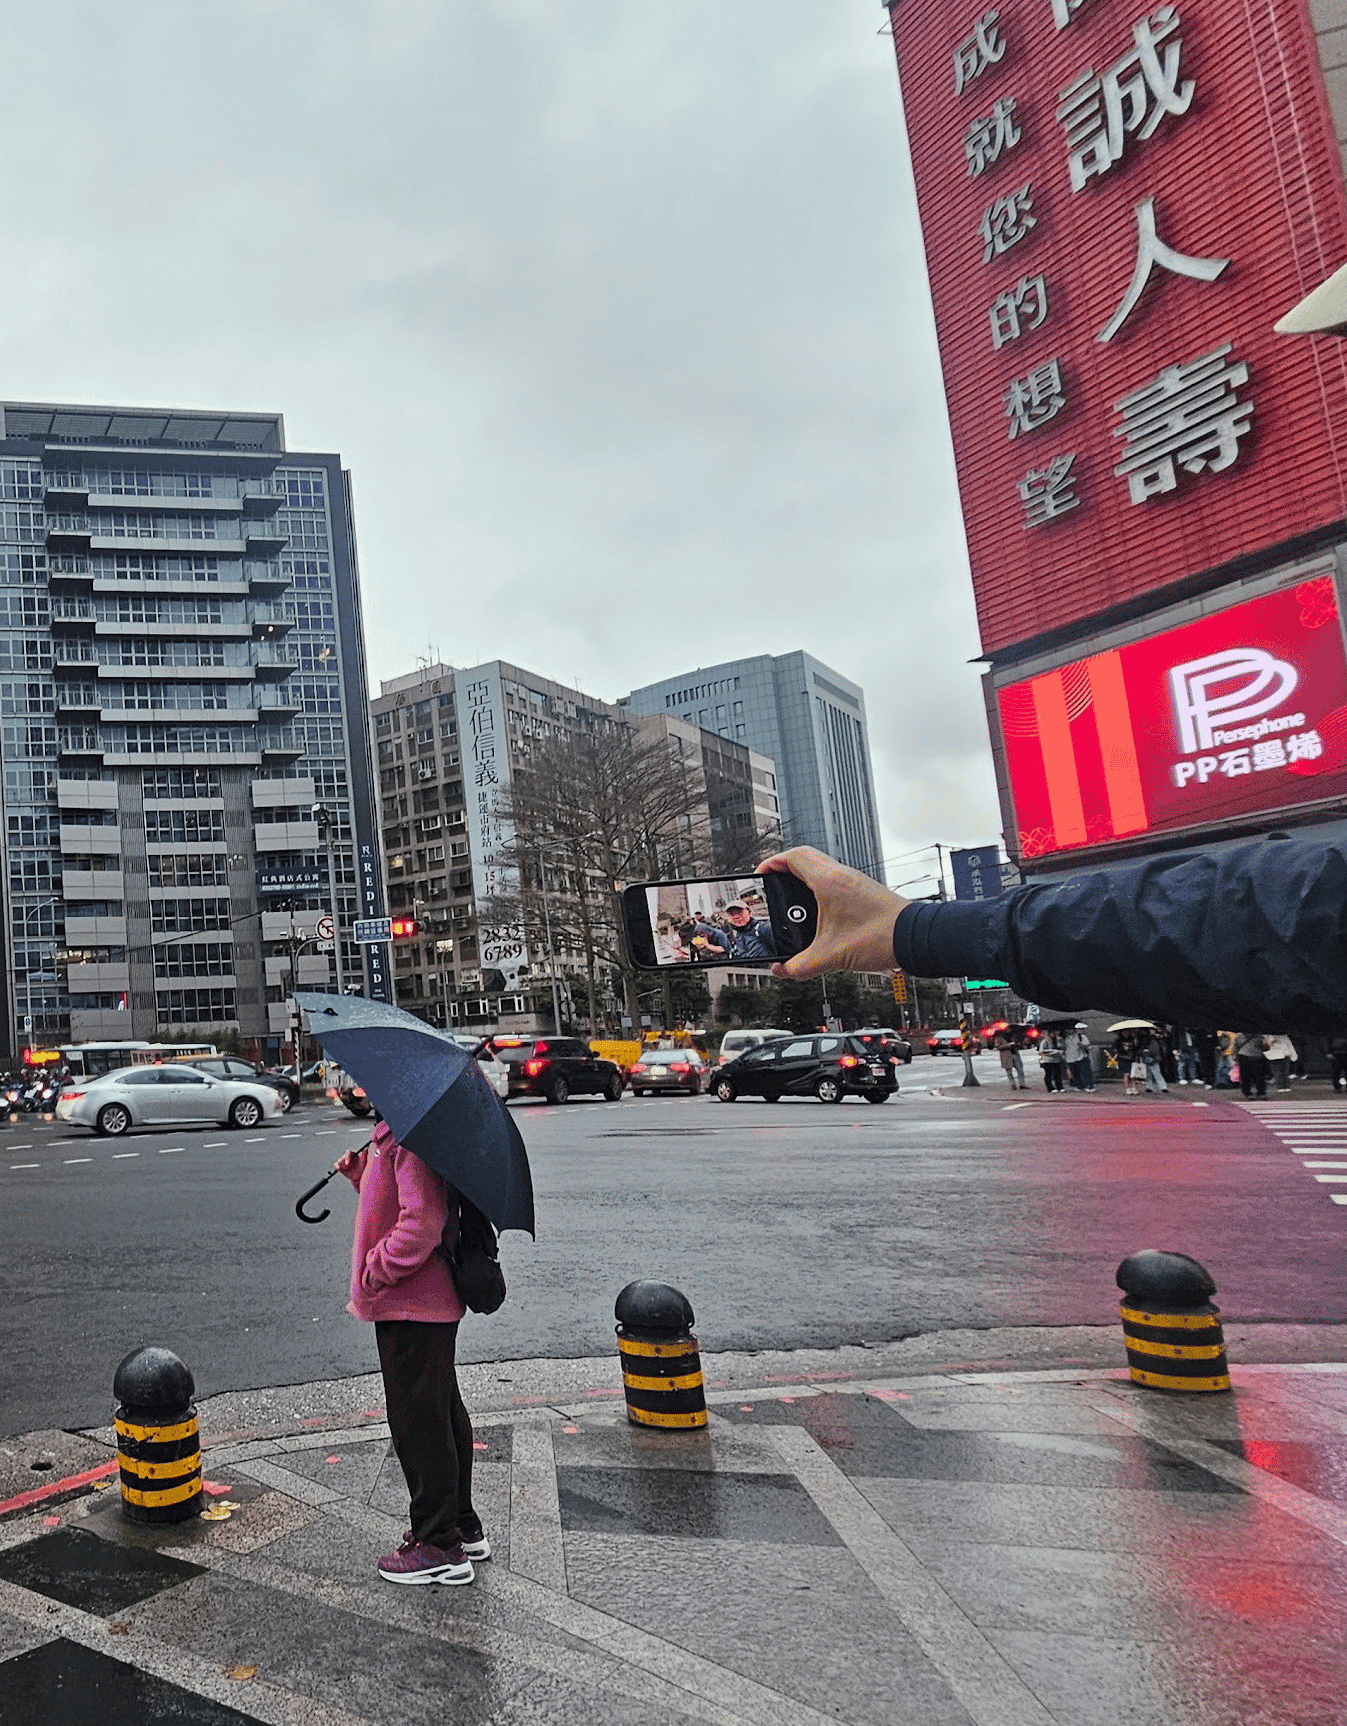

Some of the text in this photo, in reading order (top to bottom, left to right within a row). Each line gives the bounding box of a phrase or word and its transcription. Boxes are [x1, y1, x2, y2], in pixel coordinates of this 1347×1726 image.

[953, 9, 1081, 530] 成就您的想望
[1051, 0, 1254, 505] 誠人壽
[1213, 711, 1306, 747] Persephone
[1173, 729, 1323, 788] PP石墨烯
[482, 925, 521, 945] 2832
[484, 944, 522, 960] 6789
